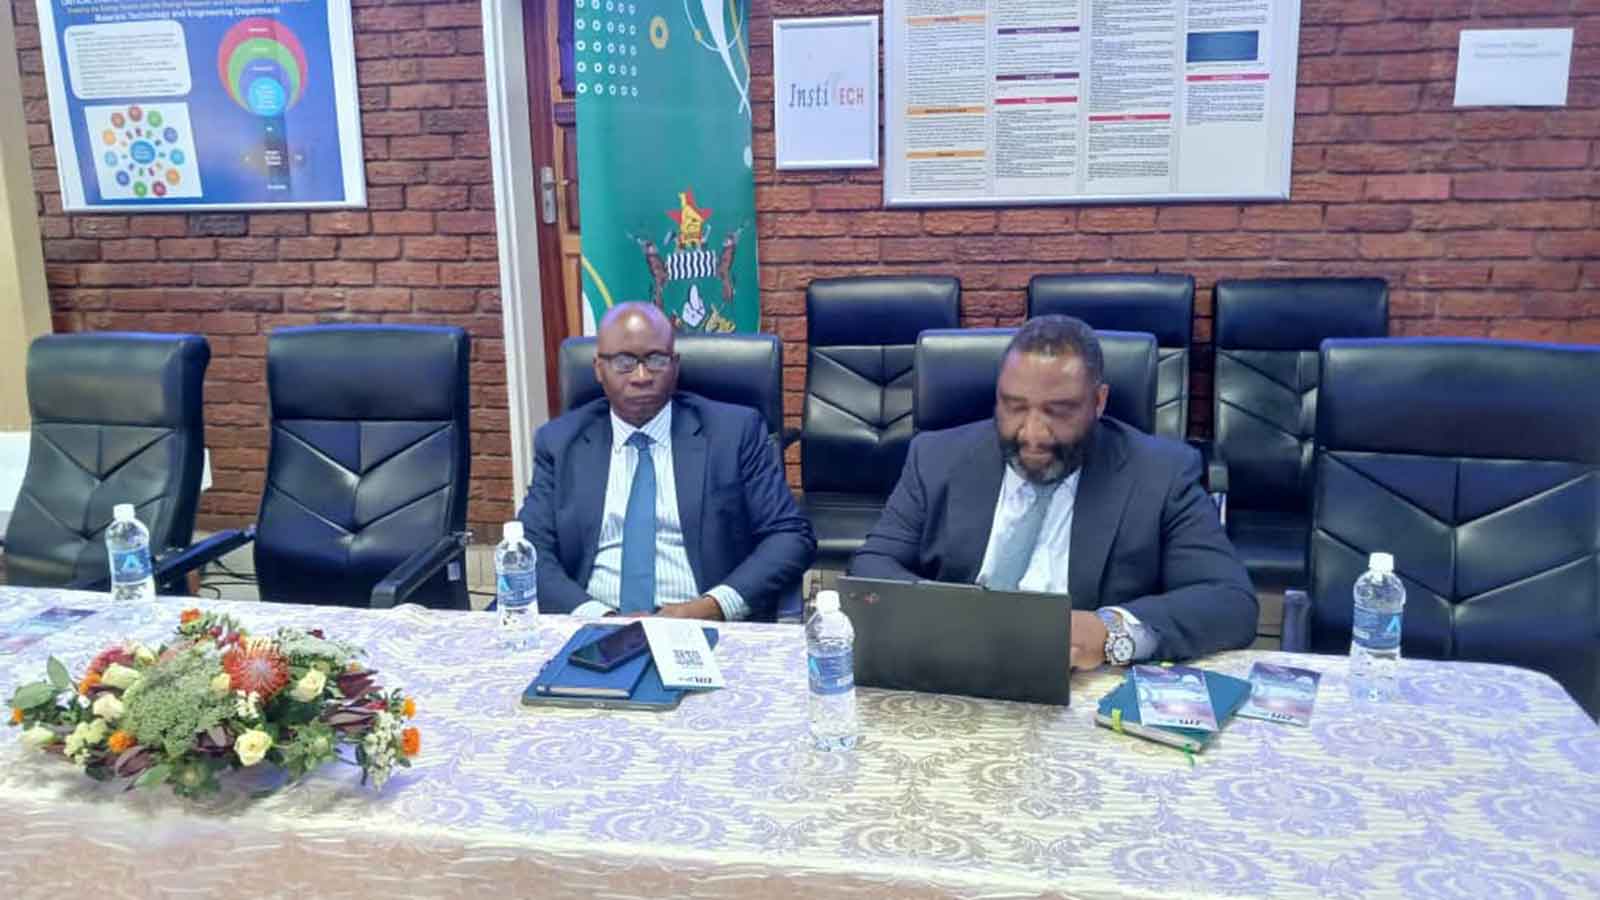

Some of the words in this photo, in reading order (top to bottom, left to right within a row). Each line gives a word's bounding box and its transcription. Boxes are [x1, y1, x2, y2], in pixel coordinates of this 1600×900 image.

[128, 10, 170, 21] Technology
[172, 9, 186, 18] and
[187, 7, 233, 19] Engineering
[234, 6, 281, 17] Department
